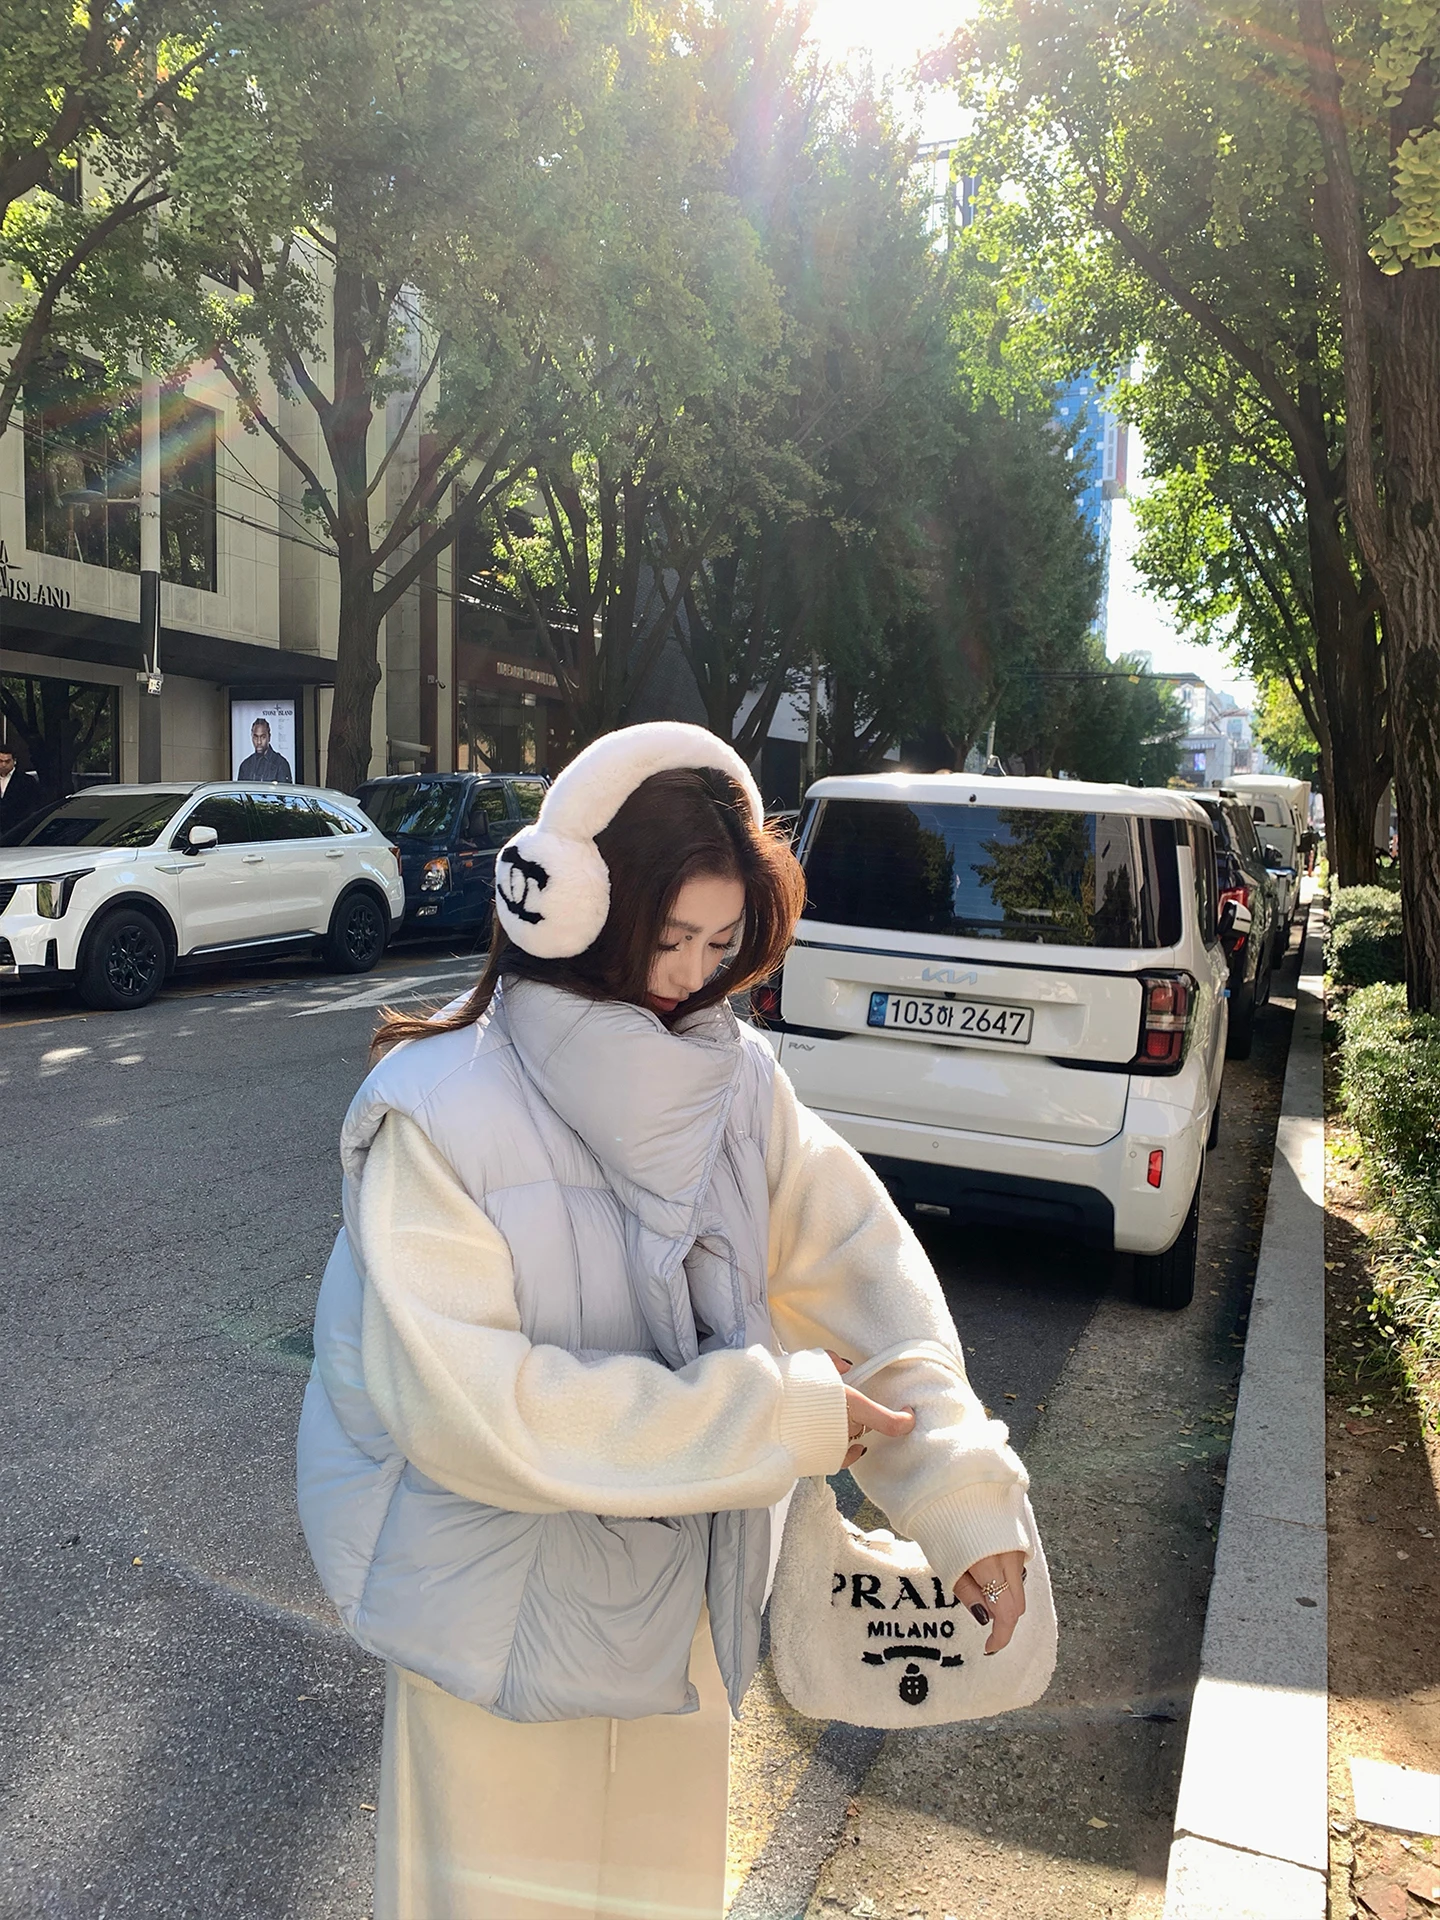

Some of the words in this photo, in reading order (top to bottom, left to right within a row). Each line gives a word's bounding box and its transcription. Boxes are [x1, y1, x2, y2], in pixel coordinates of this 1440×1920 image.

[9, 578, 71, 609] ISLAND
[921, 966, 978, 986] KIA
[891, 1000, 954, 1027] 103하
[960, 1006, 1026, 1036] 2647
[788, 1041, 816, 1052] RAY
[867, 1619, 955, 1639] MILANO
